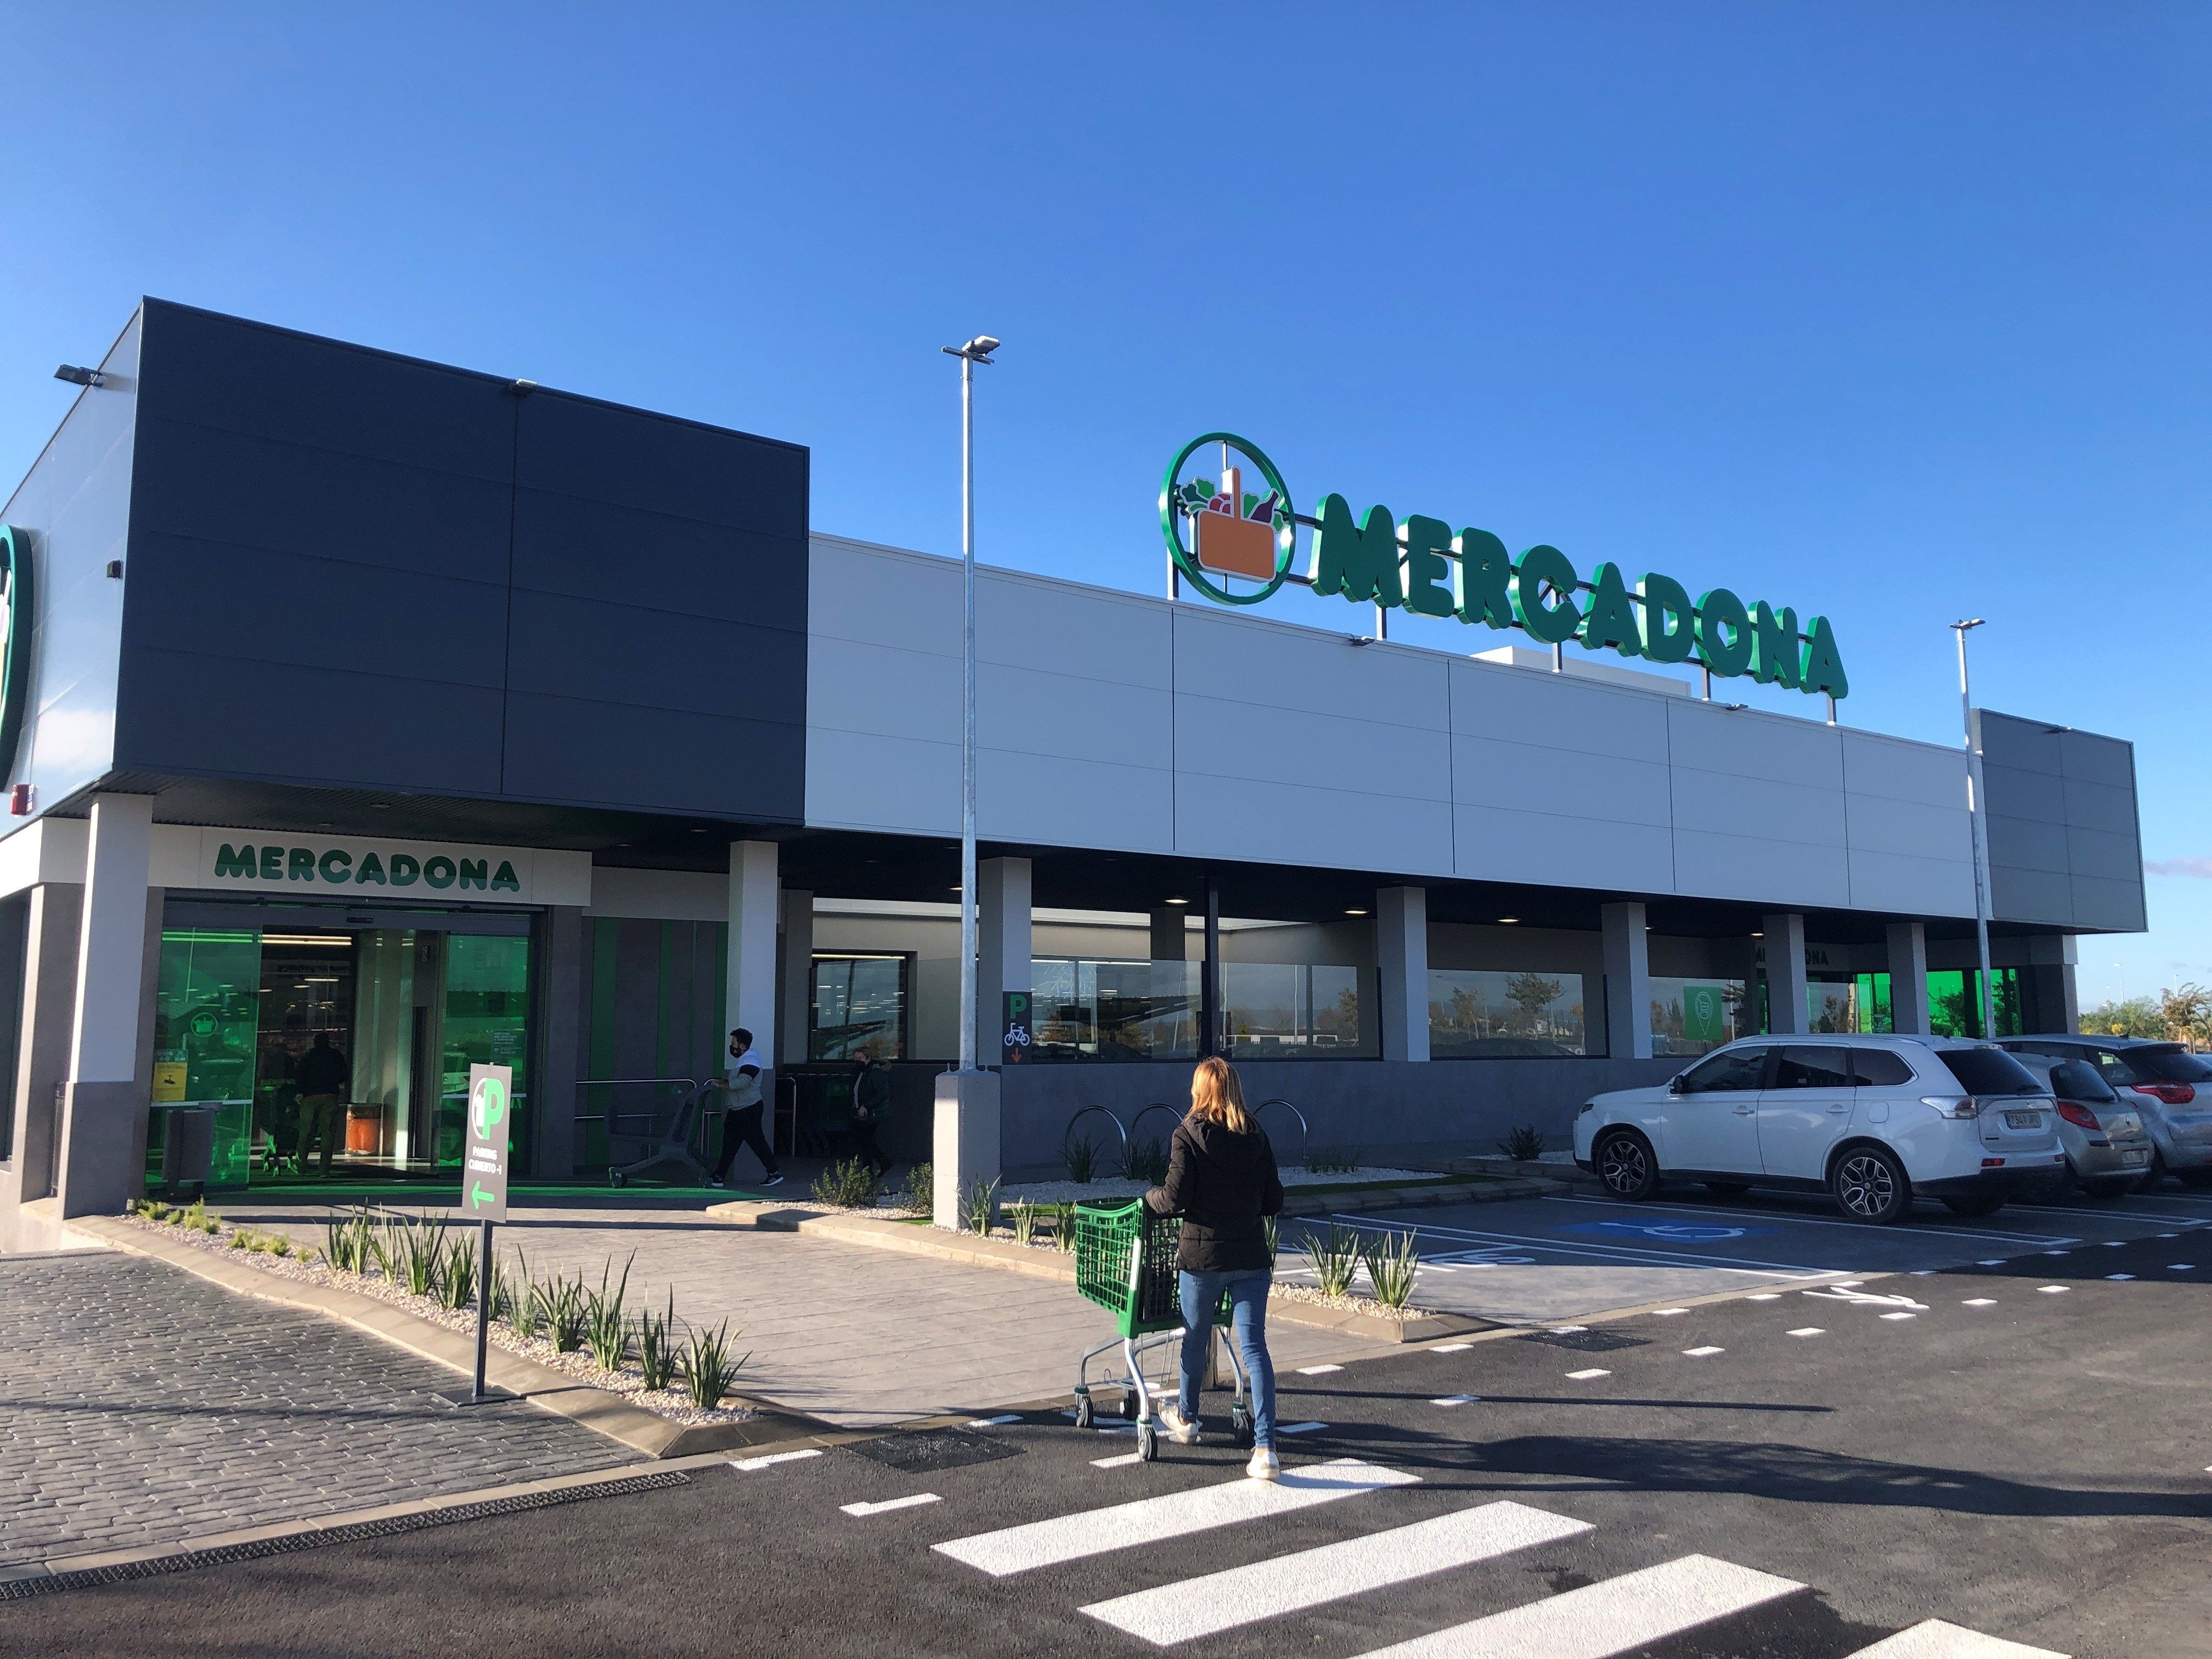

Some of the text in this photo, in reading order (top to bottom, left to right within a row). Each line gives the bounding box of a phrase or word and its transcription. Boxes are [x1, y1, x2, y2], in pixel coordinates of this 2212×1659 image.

[1310, 493, 1849, 699] MERCADONA
[215, 843, 520, 892] MERCADONA
[1009, 994, 1028, 1019] P
[482, 1078, 505, 1140] P
